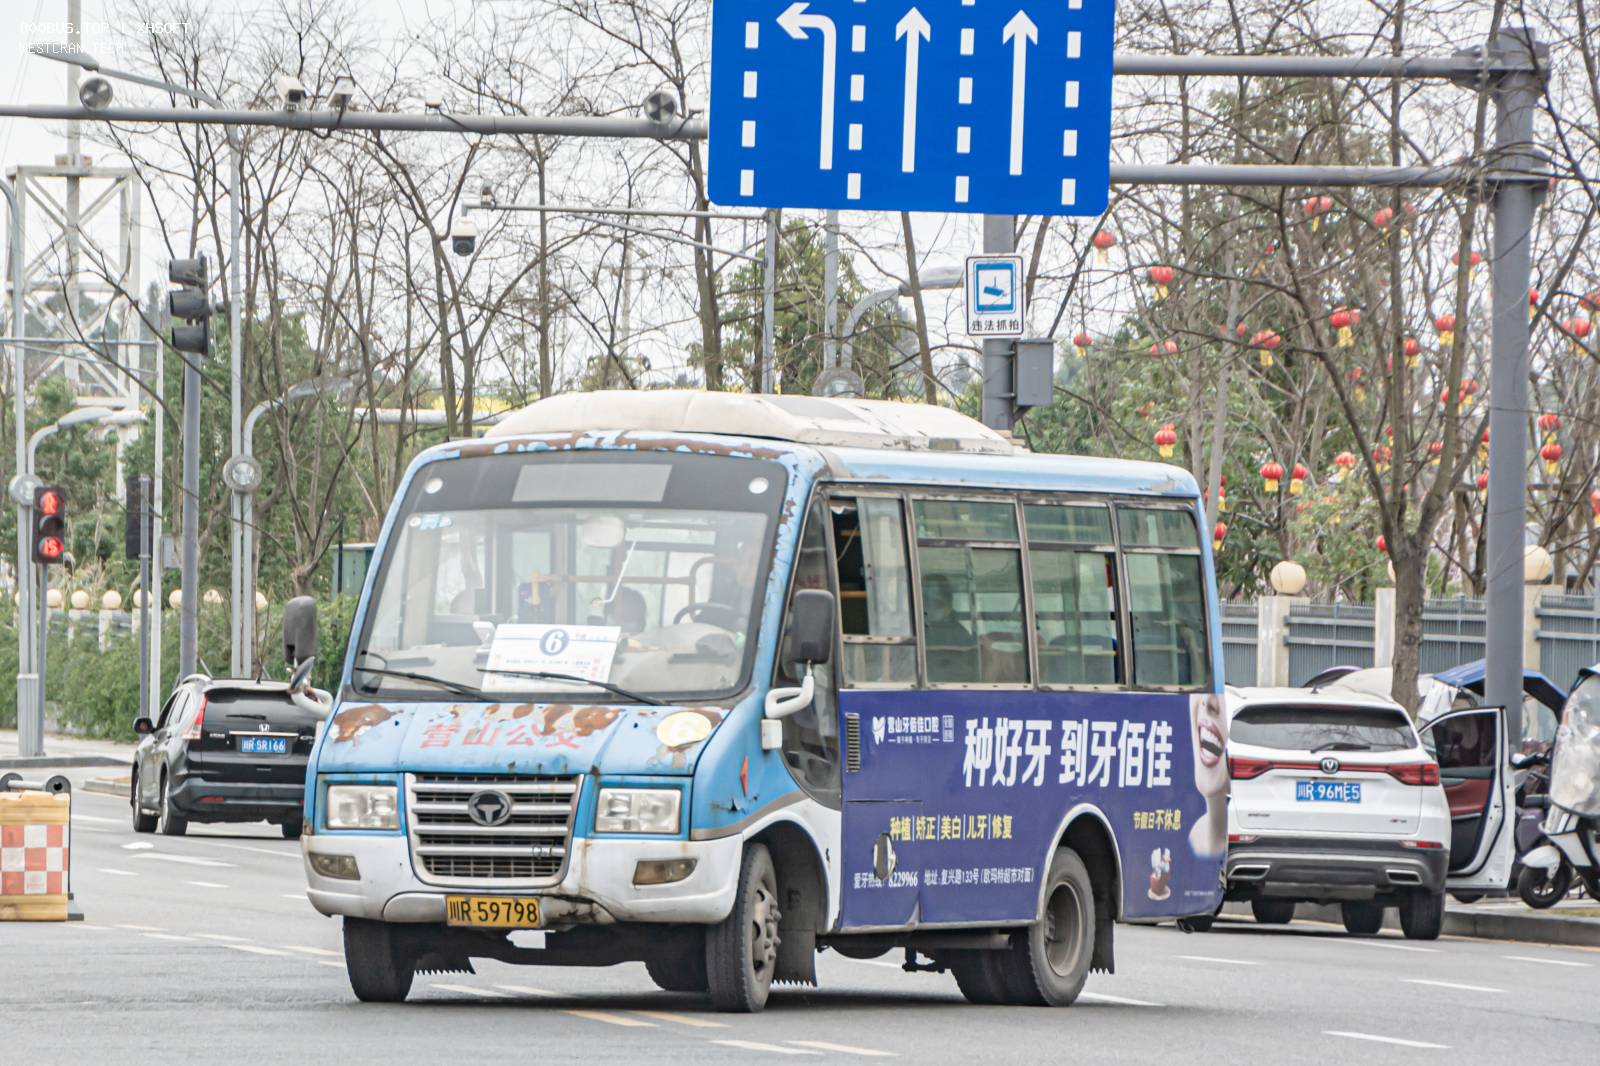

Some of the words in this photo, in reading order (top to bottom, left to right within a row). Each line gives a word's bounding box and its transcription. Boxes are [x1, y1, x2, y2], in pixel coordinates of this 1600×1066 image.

[972, 319, 1020, 331] 违法抓拍
[545, 629, 565, 655] 6
[420, 722, 584, 749] 营山公交
[963, 717, 1052, 789] 种好牙
[1059, 717, 1173, 789] 到牙佰佳
[1133, 808, 1182, 831] 节假日不休息
